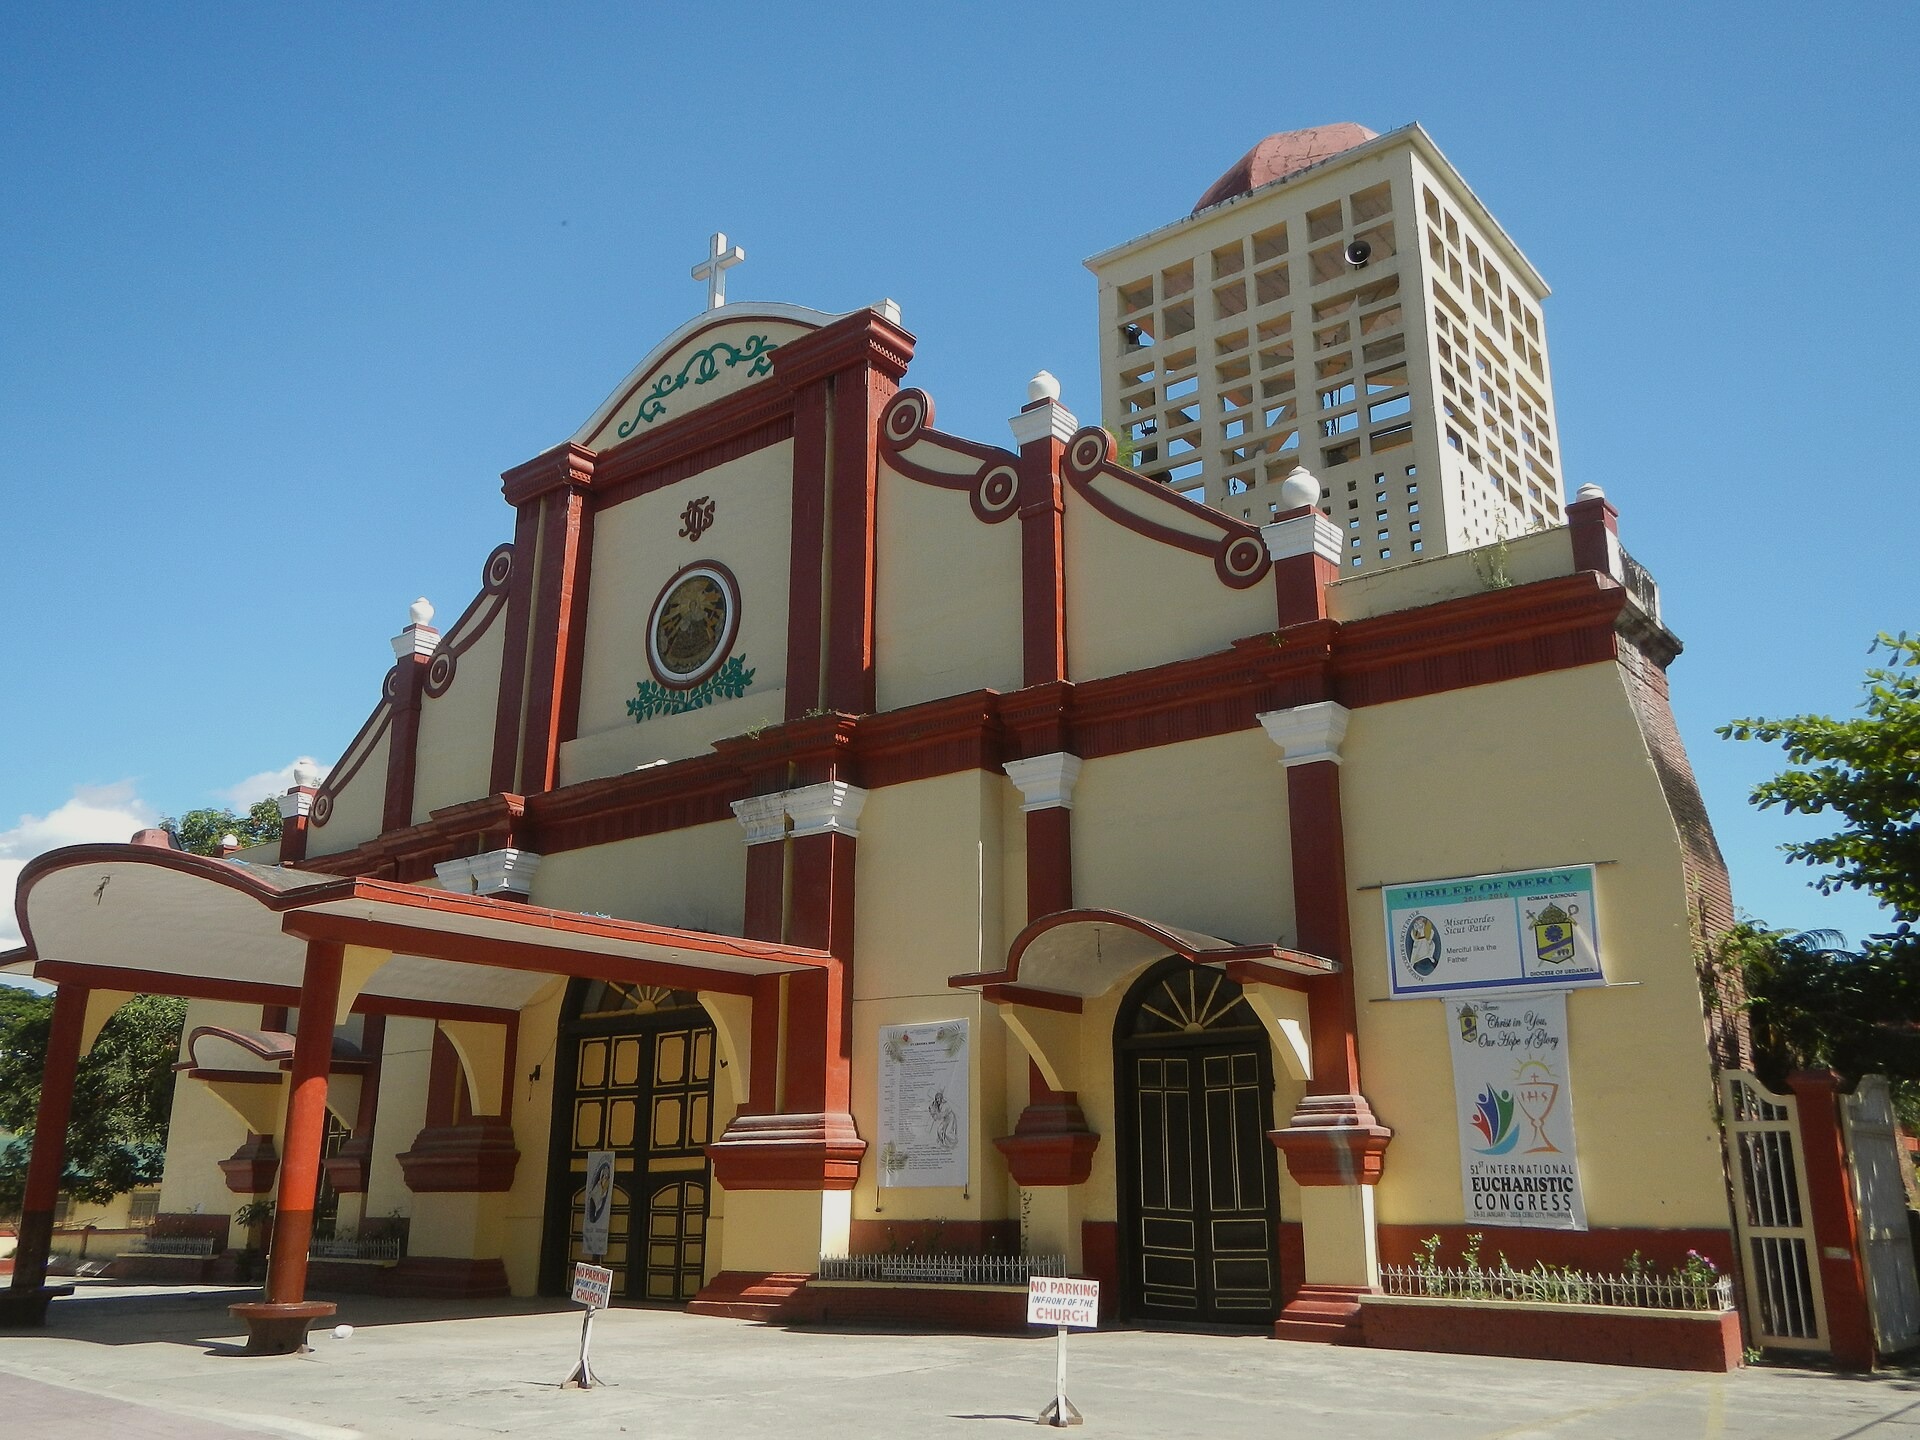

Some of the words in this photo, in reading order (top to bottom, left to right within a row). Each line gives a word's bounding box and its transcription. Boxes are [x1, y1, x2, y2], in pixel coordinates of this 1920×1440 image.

[1404, 885, 1474, 901] JUBILEE
[1480, 881, 1503, 893] OF
[1508, 874, 1574, 891] MERCY
[1527, 894, 1548, 902] ROMAN
[1549, 891, 1578, 900] CATHOLIC
[1444, 914, 1495, 927] Misericordes
[1444, 926, 1466, 935] Sicut
[1468, 923, 1492, 932] Pater
[1446, 945, 1472, 954] Merciful
[1486, 943, 1497, 951] the
[1485, 1012, 1512, 1029] Christ
[1512, 1017, 1521, 1028] in
[1478, 1033, 1495, 1048] Our
[1498, 1030, 1521, 1051] Hope
[1524, 1032, 1534, 1050] of
[1533, 1027, 1559, 1051] Glory
[1520, 1090, 1548, 1103] IHS
[1485, 1164, 1574, 1175] INTERNATIONAL
[1471, 1177, 1574, 1193] EUCHARISTIC
[1474, 1193, 1572, 1211] CONGRESS
[576, 1265, 585, 1277] NO
[585, 1268, 609, 1284] PARKING
[591, 1282, 598, 1290] OF
[598, 1283, 607, 1293] THE
[1030, 1281, 1047, 1293] NO
[1050, 1281, 1098, 1297] PARKING
[576, 1288, 603, 1305] CHURCH
[1031, 1295, 1067, 1306] INFRONT
[1067, 1298, 1078, 1306] OF
[1079, 1298, 1095, 1308] THE
[1036, 1307, 1089, 1323] CHURCH
